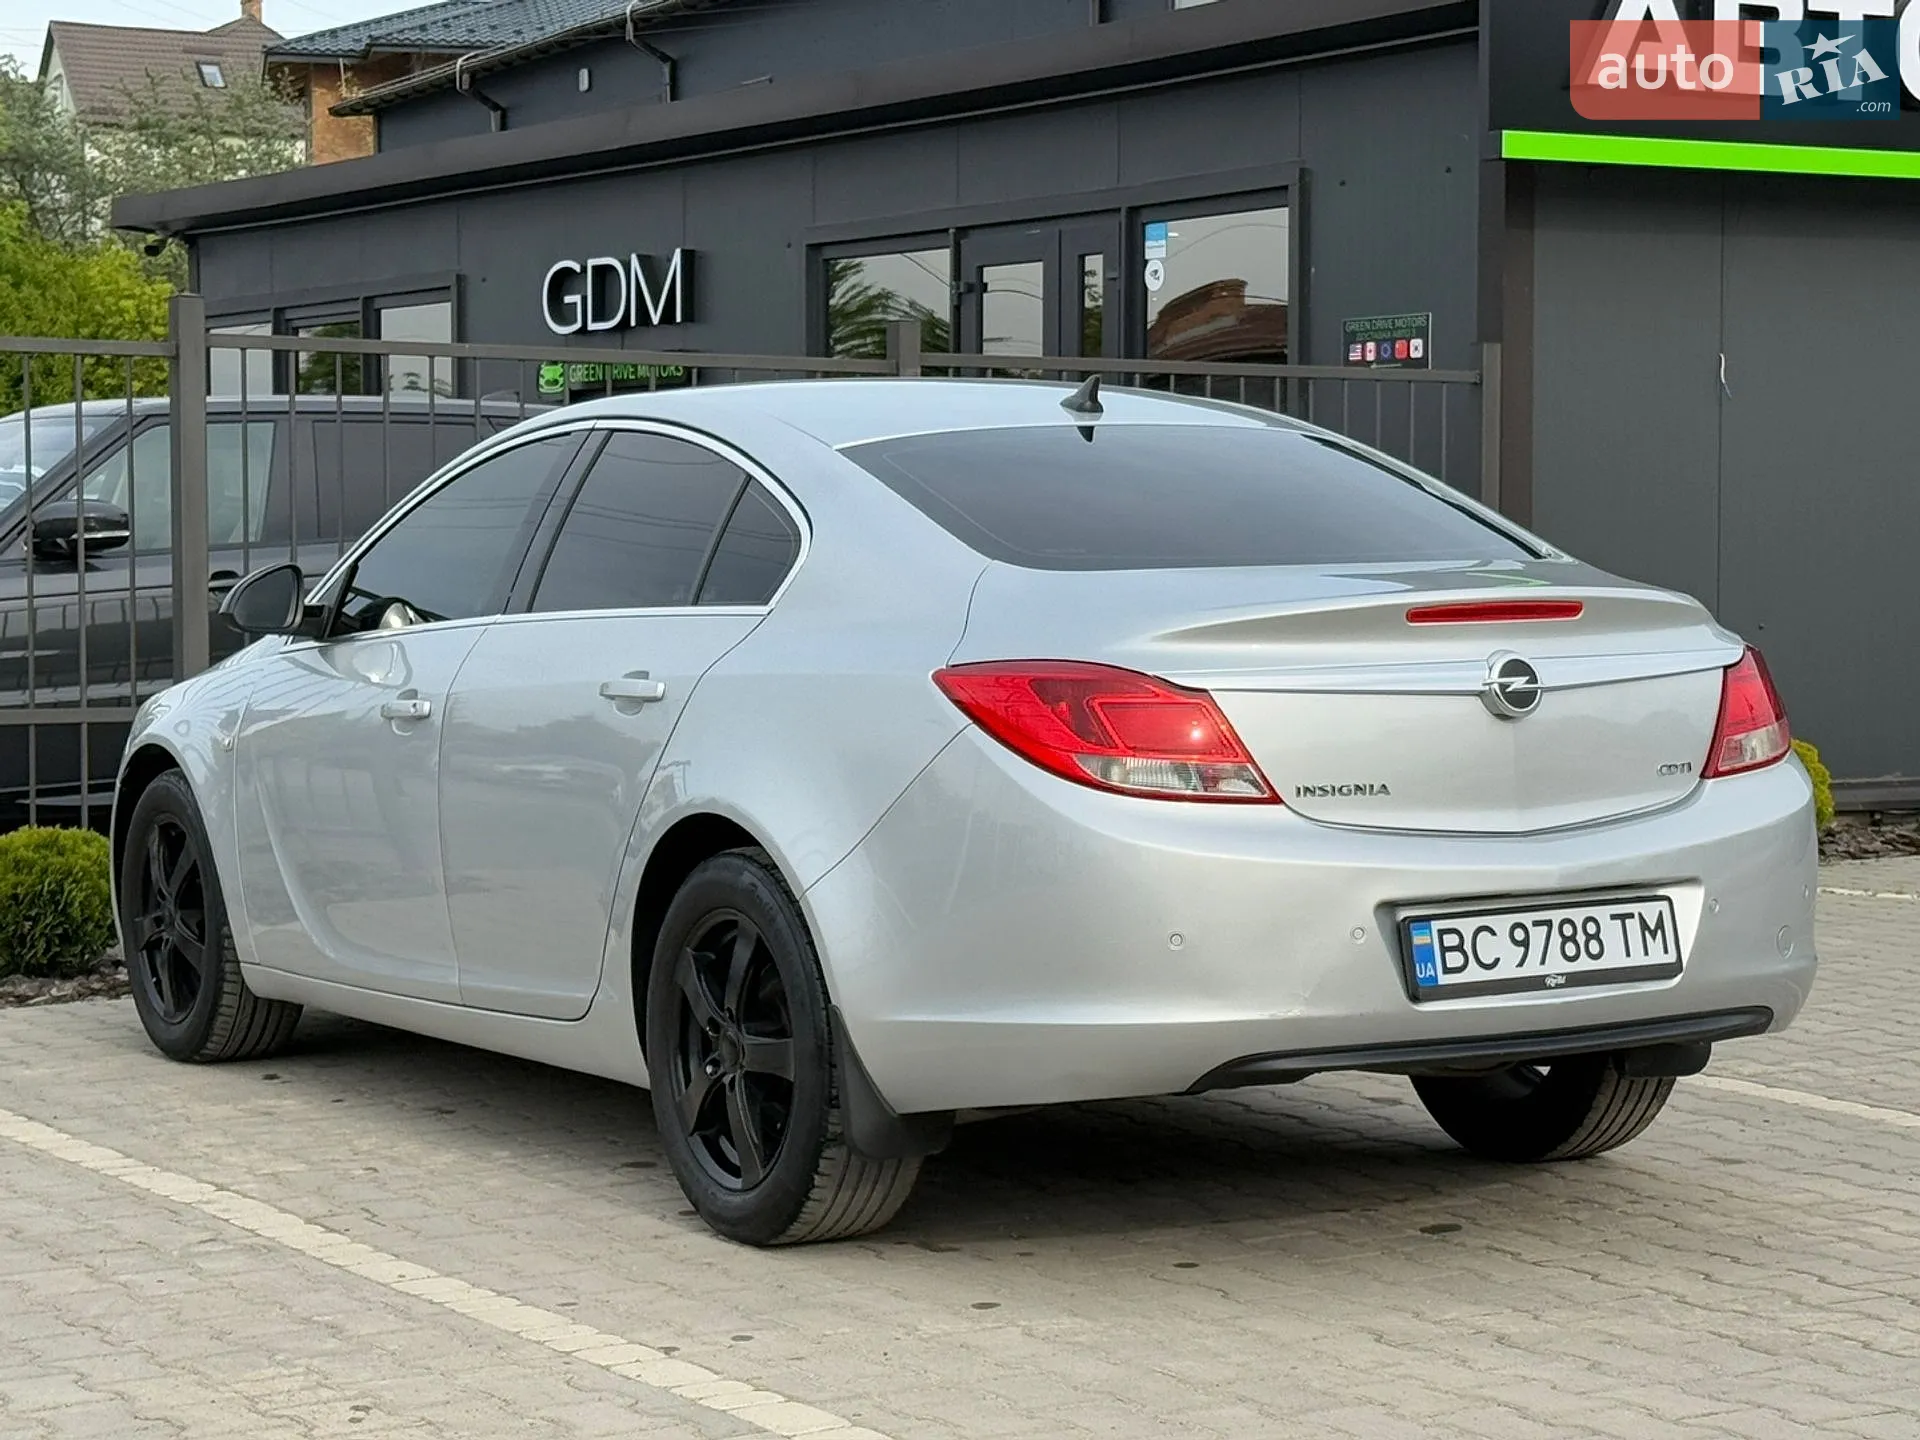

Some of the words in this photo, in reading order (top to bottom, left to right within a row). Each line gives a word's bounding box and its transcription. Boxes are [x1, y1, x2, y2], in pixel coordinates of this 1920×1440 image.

[1584, 0, 1920, 103] АВТ
[541, 247, 684, 336] GDM
[1345, 321, 1371, 333] GREEN
[1372, 319, 1394, 330] DRIVE
[1395, 316, 1427, 328] MOTORS
[568, 362, 603, 382] GREEN
[611, 362, 636, 380] RIVE
[1656, 761, 1692, 777] CDTI
[1295, 782, 1392, 799] INSIGNIA
[1437, 924, 1501, 976] BC
[1508, 915, 1605, 968] 9788
[1609, 909, 1669, 958] TM
[1415, 961, 1436, 979] UA
